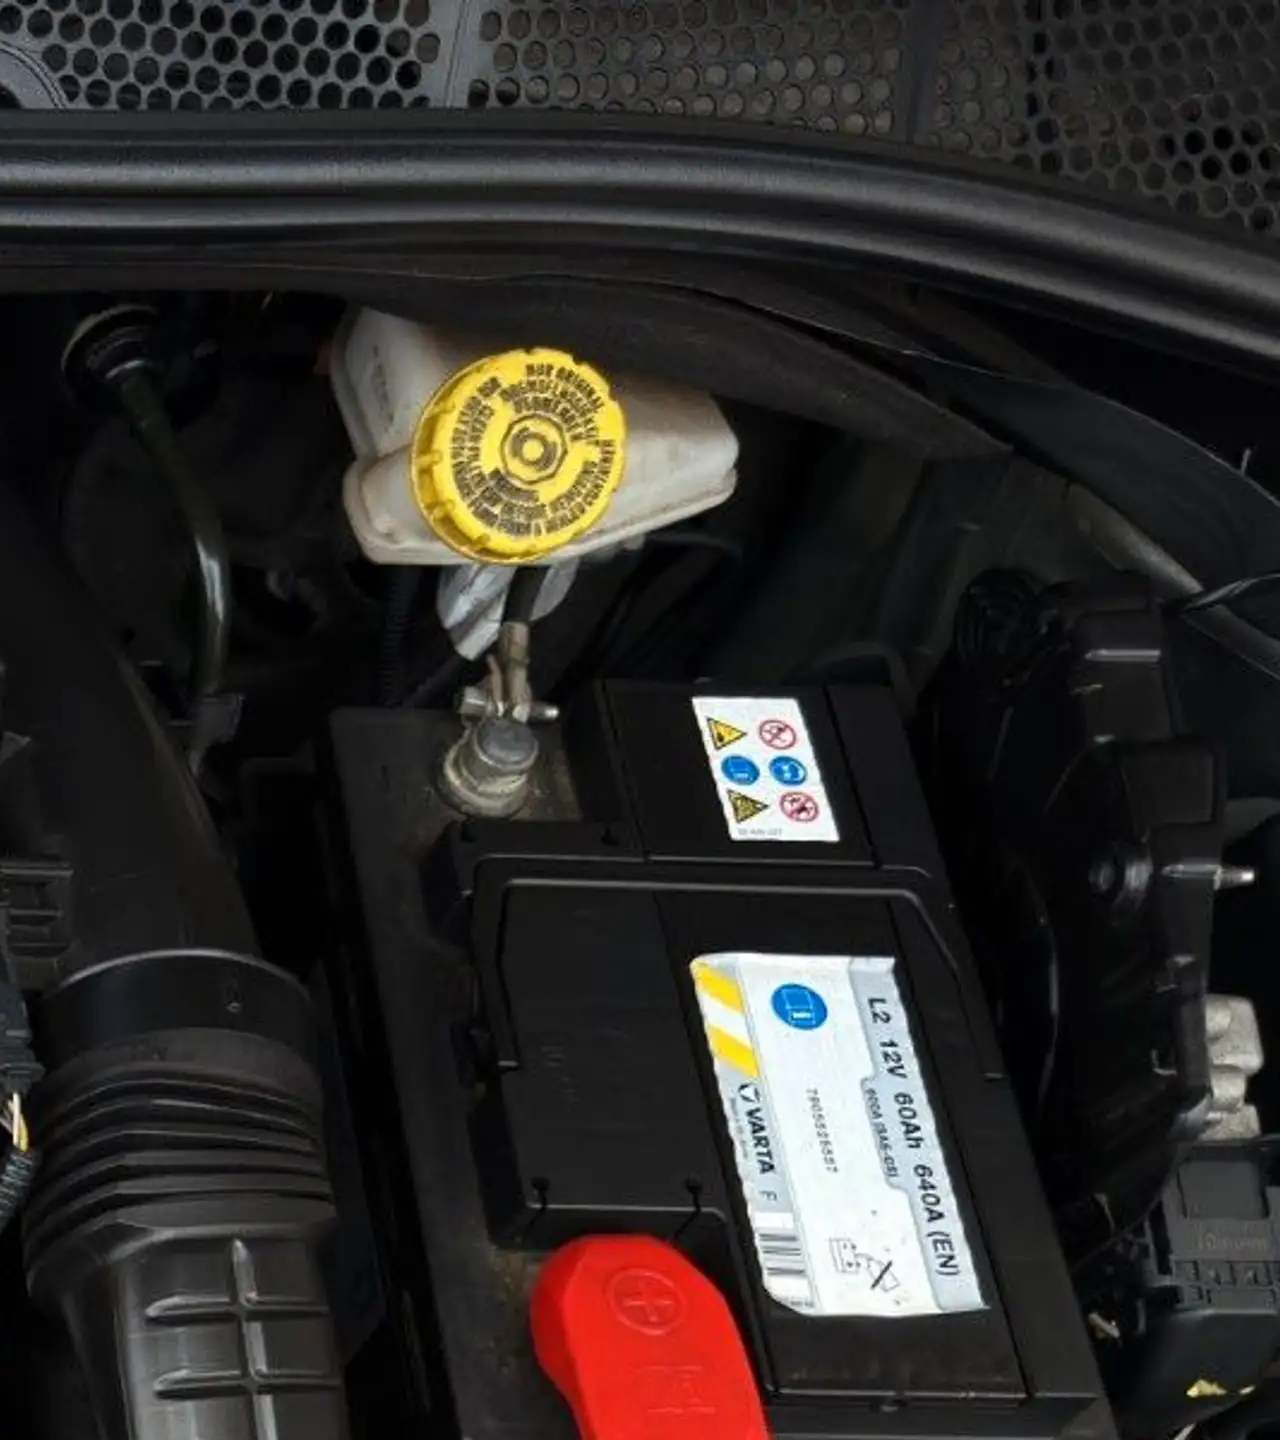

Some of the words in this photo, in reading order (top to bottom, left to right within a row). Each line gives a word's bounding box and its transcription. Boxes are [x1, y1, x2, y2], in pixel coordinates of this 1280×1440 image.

[868, 997, 891, 1024] L2
[880, 1039, 908, 1080] 12V
[745, 1107, 776, 1175] VARTA
[893, 1091, 924, 1149] 60Ah
[913, 1164, 945, 1223] 640A
[926, 1231, 961, 1277] (EN)
